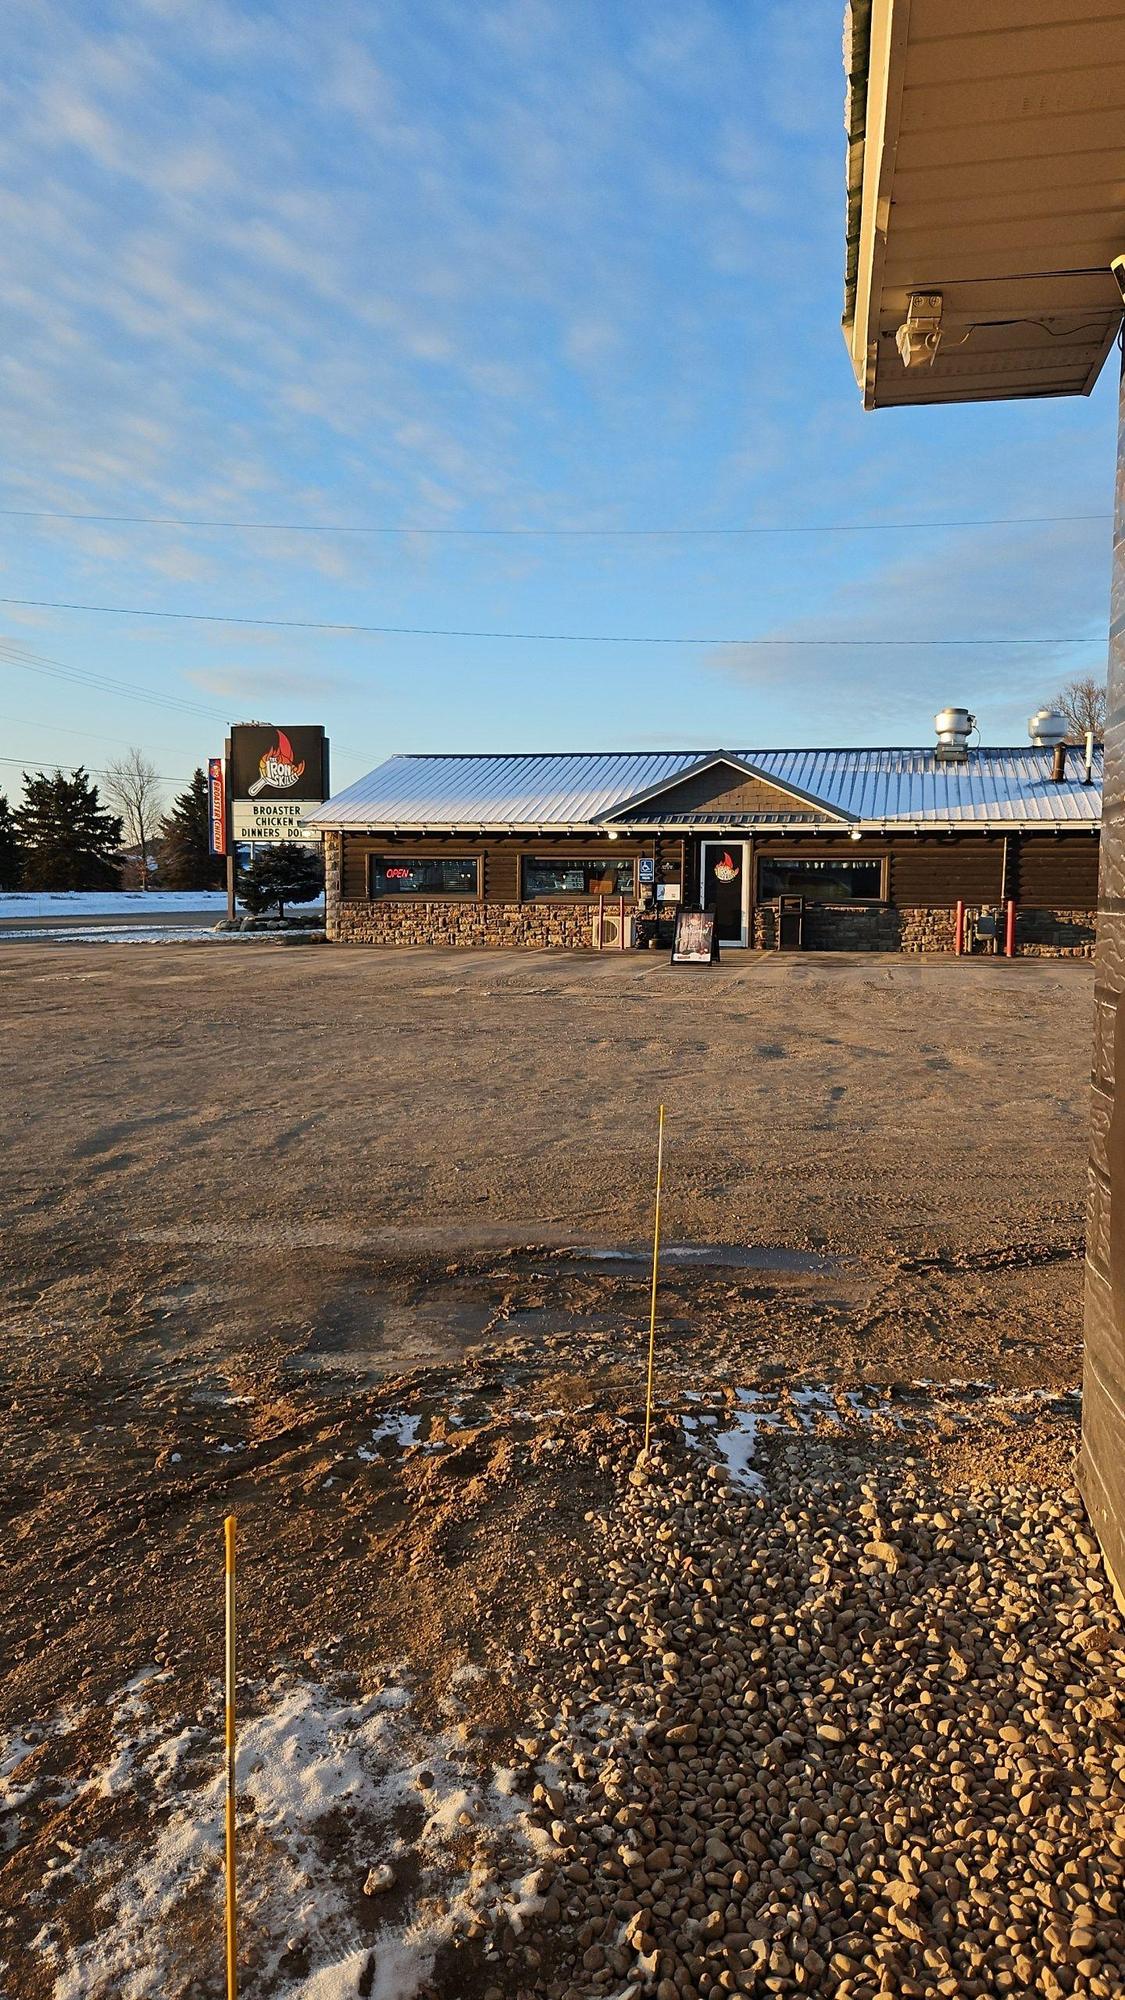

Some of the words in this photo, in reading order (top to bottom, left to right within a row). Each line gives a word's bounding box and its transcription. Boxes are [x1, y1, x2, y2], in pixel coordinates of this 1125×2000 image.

[266, 760, 291, 779] IRON
[274, 772, 299, 786] SKILLET
[213, 780, 222, 819] BROASTER
[253, 806, 301, 815] BROASTER
[255, 817, 294, 826] CHICKEN
[214, 820, 223, 852] CHICKEN
[241, 828, 280, 837] DINNERS
[386, 868, 409, 878] OPEN
